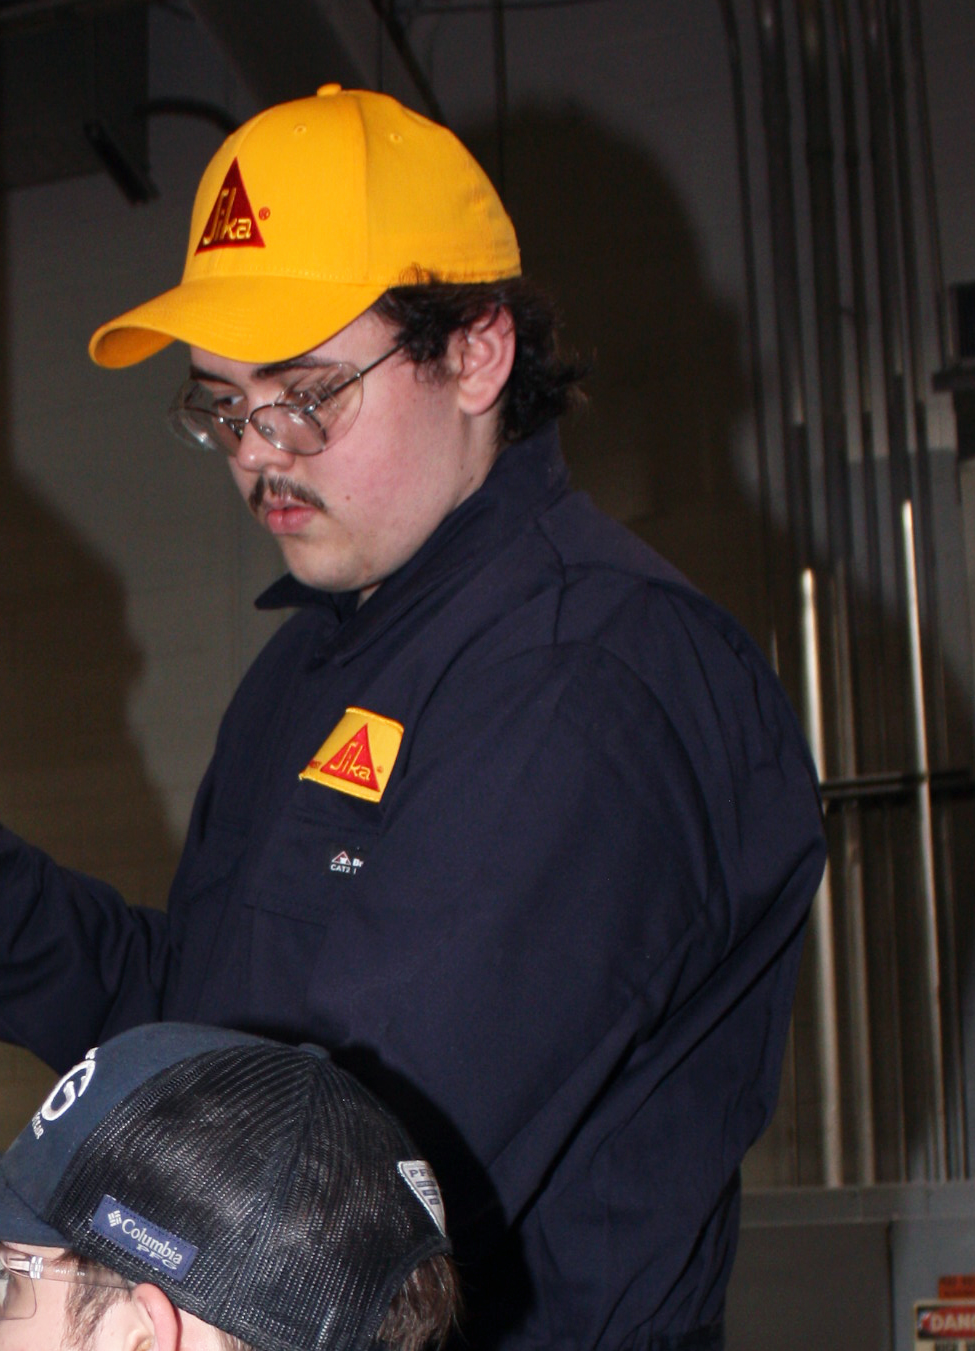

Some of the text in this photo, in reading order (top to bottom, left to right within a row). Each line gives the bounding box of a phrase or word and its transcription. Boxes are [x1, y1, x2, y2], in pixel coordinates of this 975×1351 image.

[202, 187, 252, 246] Sika
[329, 742, 371, 782] Sika
[330, 864, 351, 874] CAT2
[121, 1218, 183, 1265] Columbia
[136, 1243, 178, 1270] PFG
